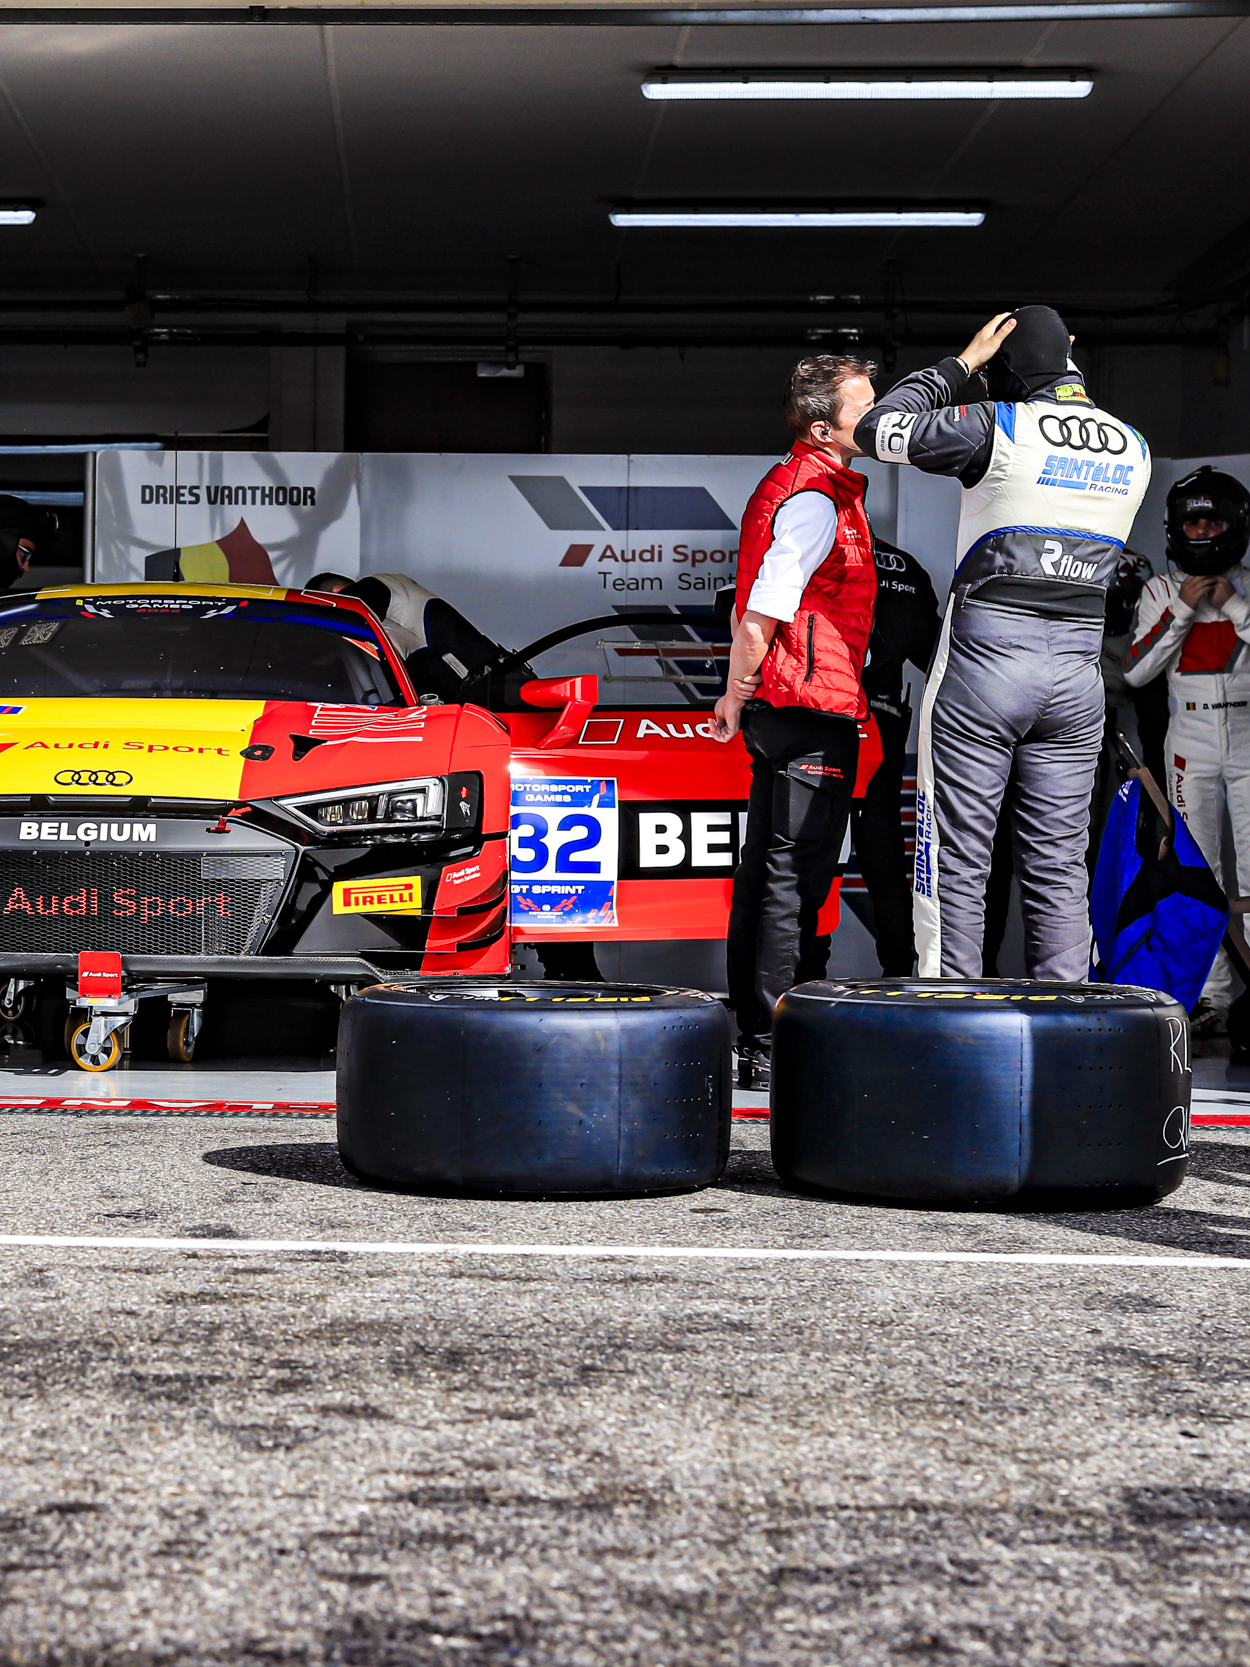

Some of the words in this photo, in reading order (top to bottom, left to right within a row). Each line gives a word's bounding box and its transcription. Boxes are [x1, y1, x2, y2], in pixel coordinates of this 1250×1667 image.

[141, 485, 200, 505] DRIES
[206, 485, 316, 506] VANTHOOR
[1088, 483, 1129, 496] RACING
[598, 544, 663, 563] Audi
[1040, 539, 1098, 580] Rflow
[598, 571, 663, 591] Team
[891, 580, 916, 594] Sport
[96, 599, 226, 607] MOTORSPORT
[22, 740, 111, 751] Audi
[123, 741, 231, 757] Sport
[524, 794, 572, 803] GAMES
[1175, 772, 1187, 808] Audi
[19, 821, 157, 843] BELGIUM
[511, 812, 602, 874] 32
[342, 883, 413, 908] PIRELLI
[511, 885, 530, 894] GT
[531, 885, 585, 895] SPRINT
[3, 887, 98, 916] Audi
[112, 888, 232, 924] Sport
[1165, 1017, 1192, 1075] RL
